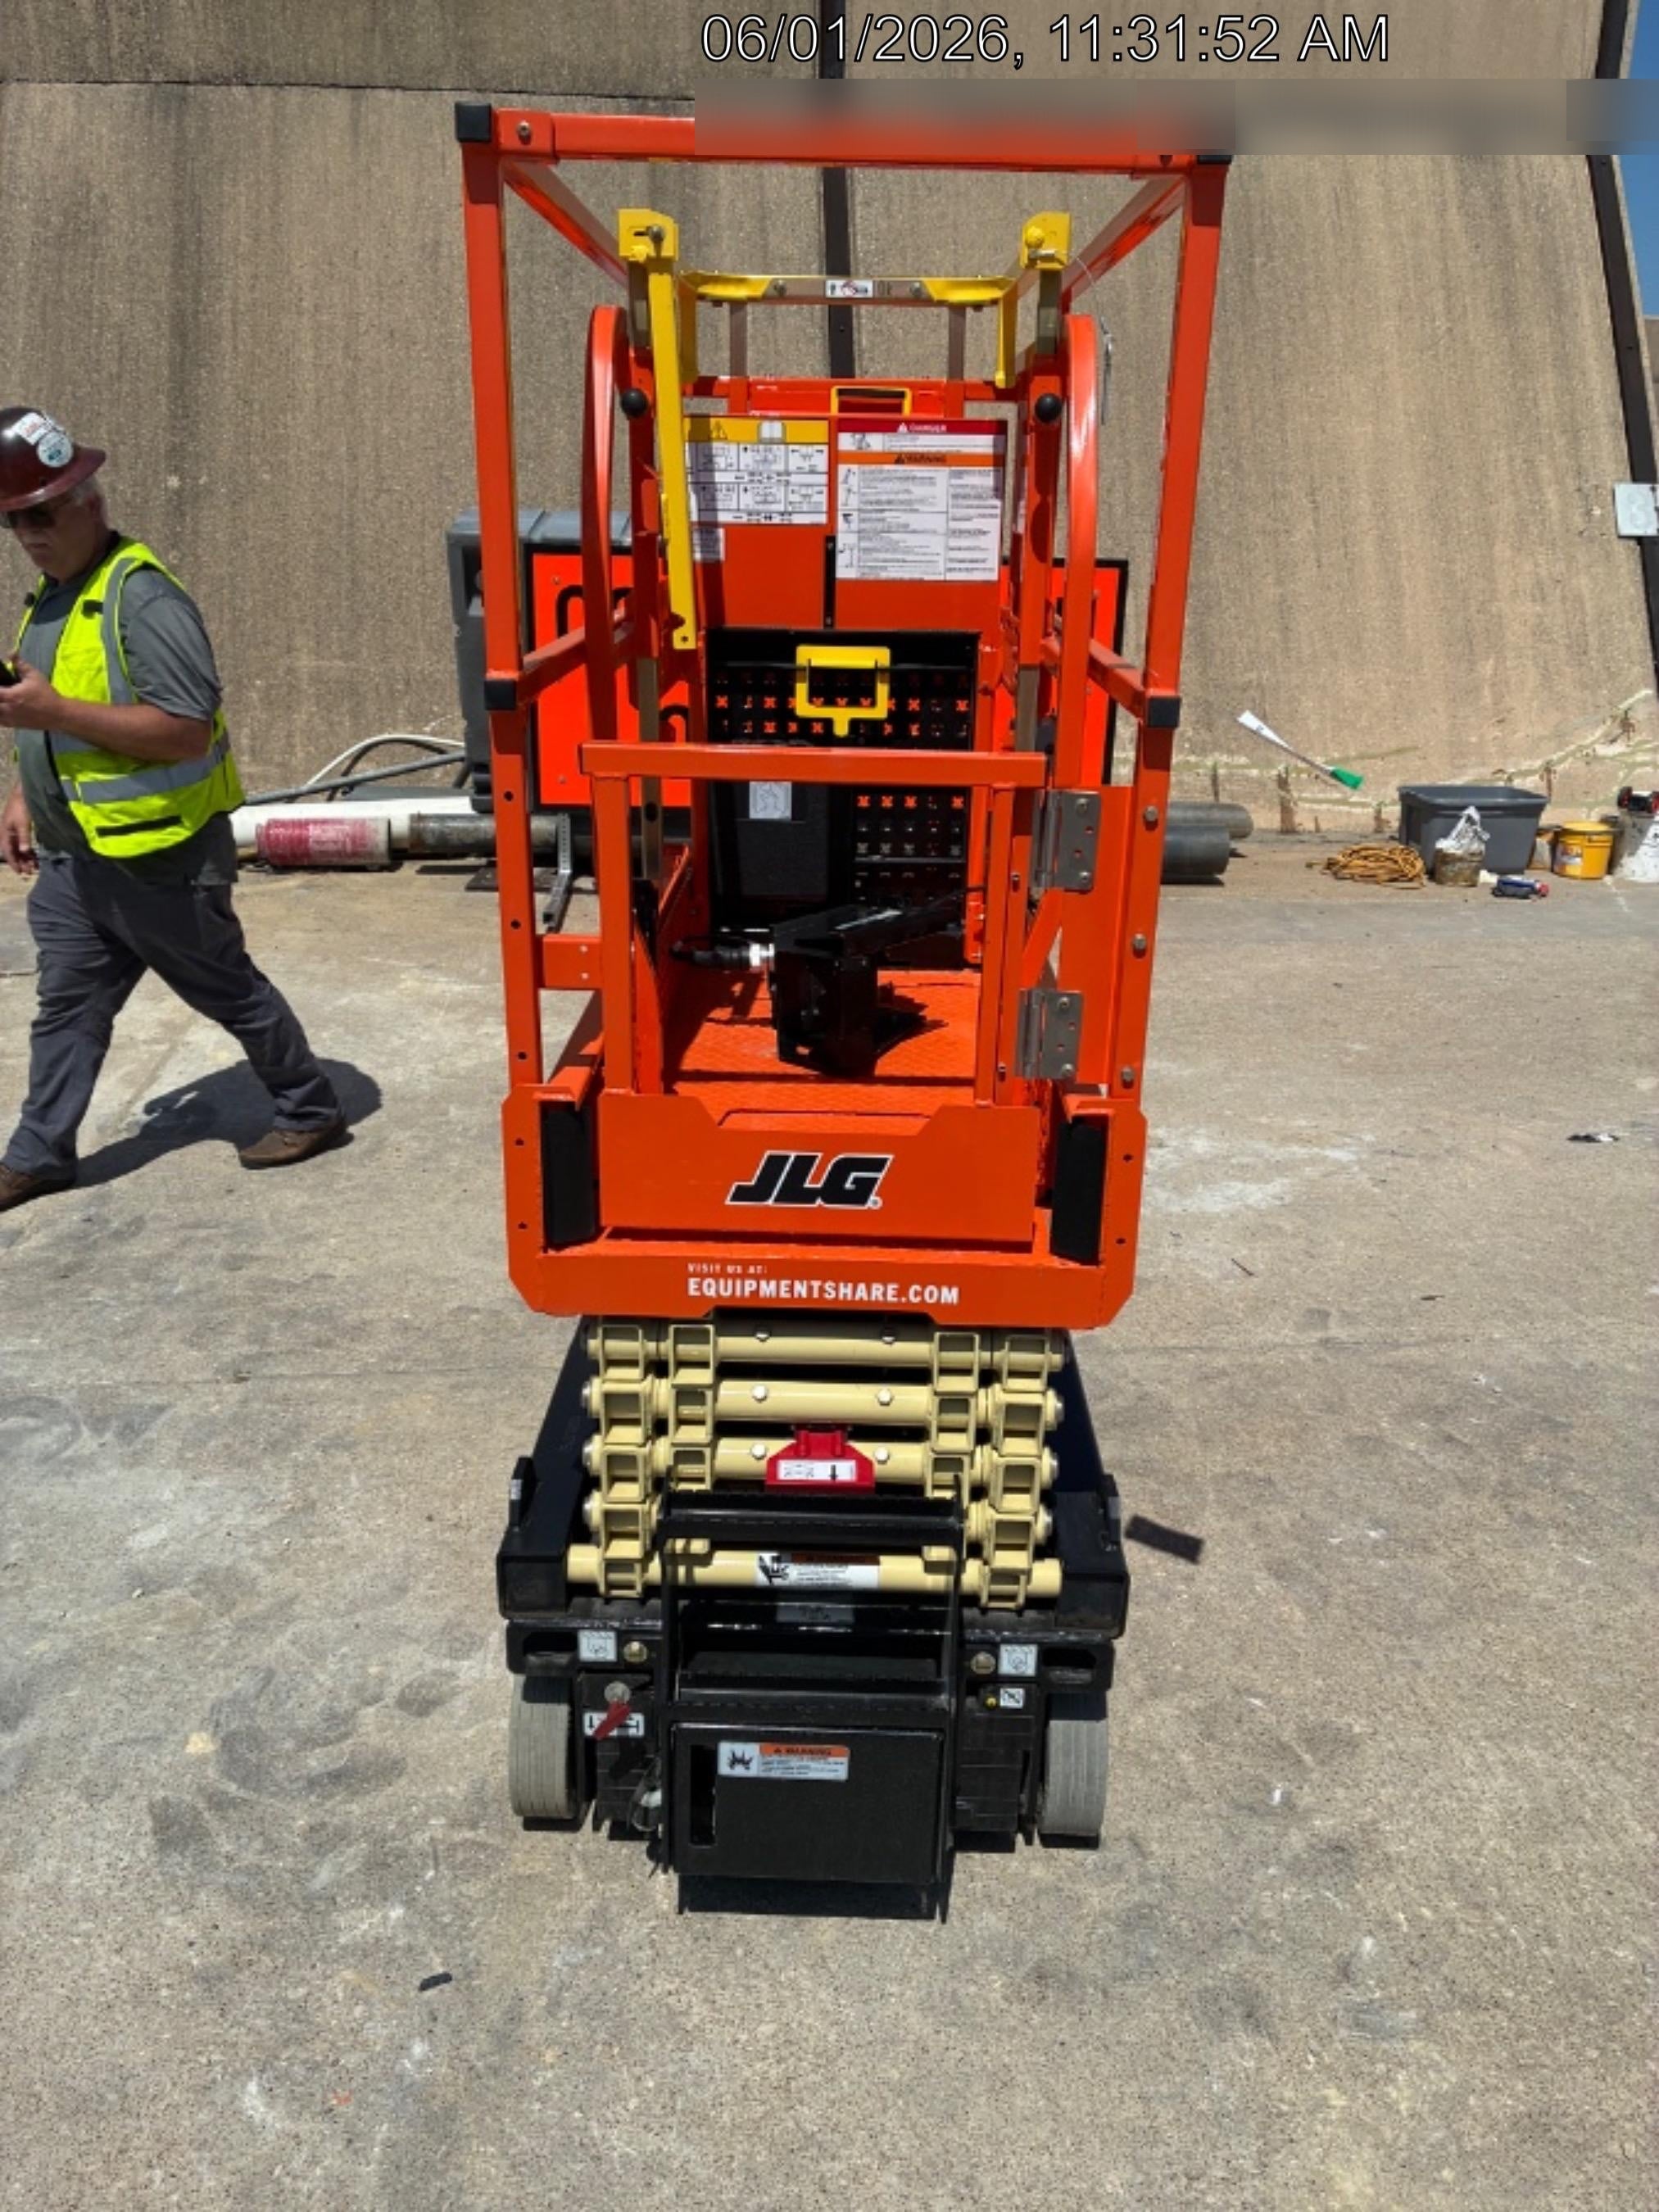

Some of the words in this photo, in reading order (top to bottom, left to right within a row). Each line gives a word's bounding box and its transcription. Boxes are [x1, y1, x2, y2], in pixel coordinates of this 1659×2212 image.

[725, 1150, 895, 1208] JLG
[687, 1262, 721, 1274] VISIT
[687, 1277, 959, 1305] EQUIPMENTSHARE.COM
